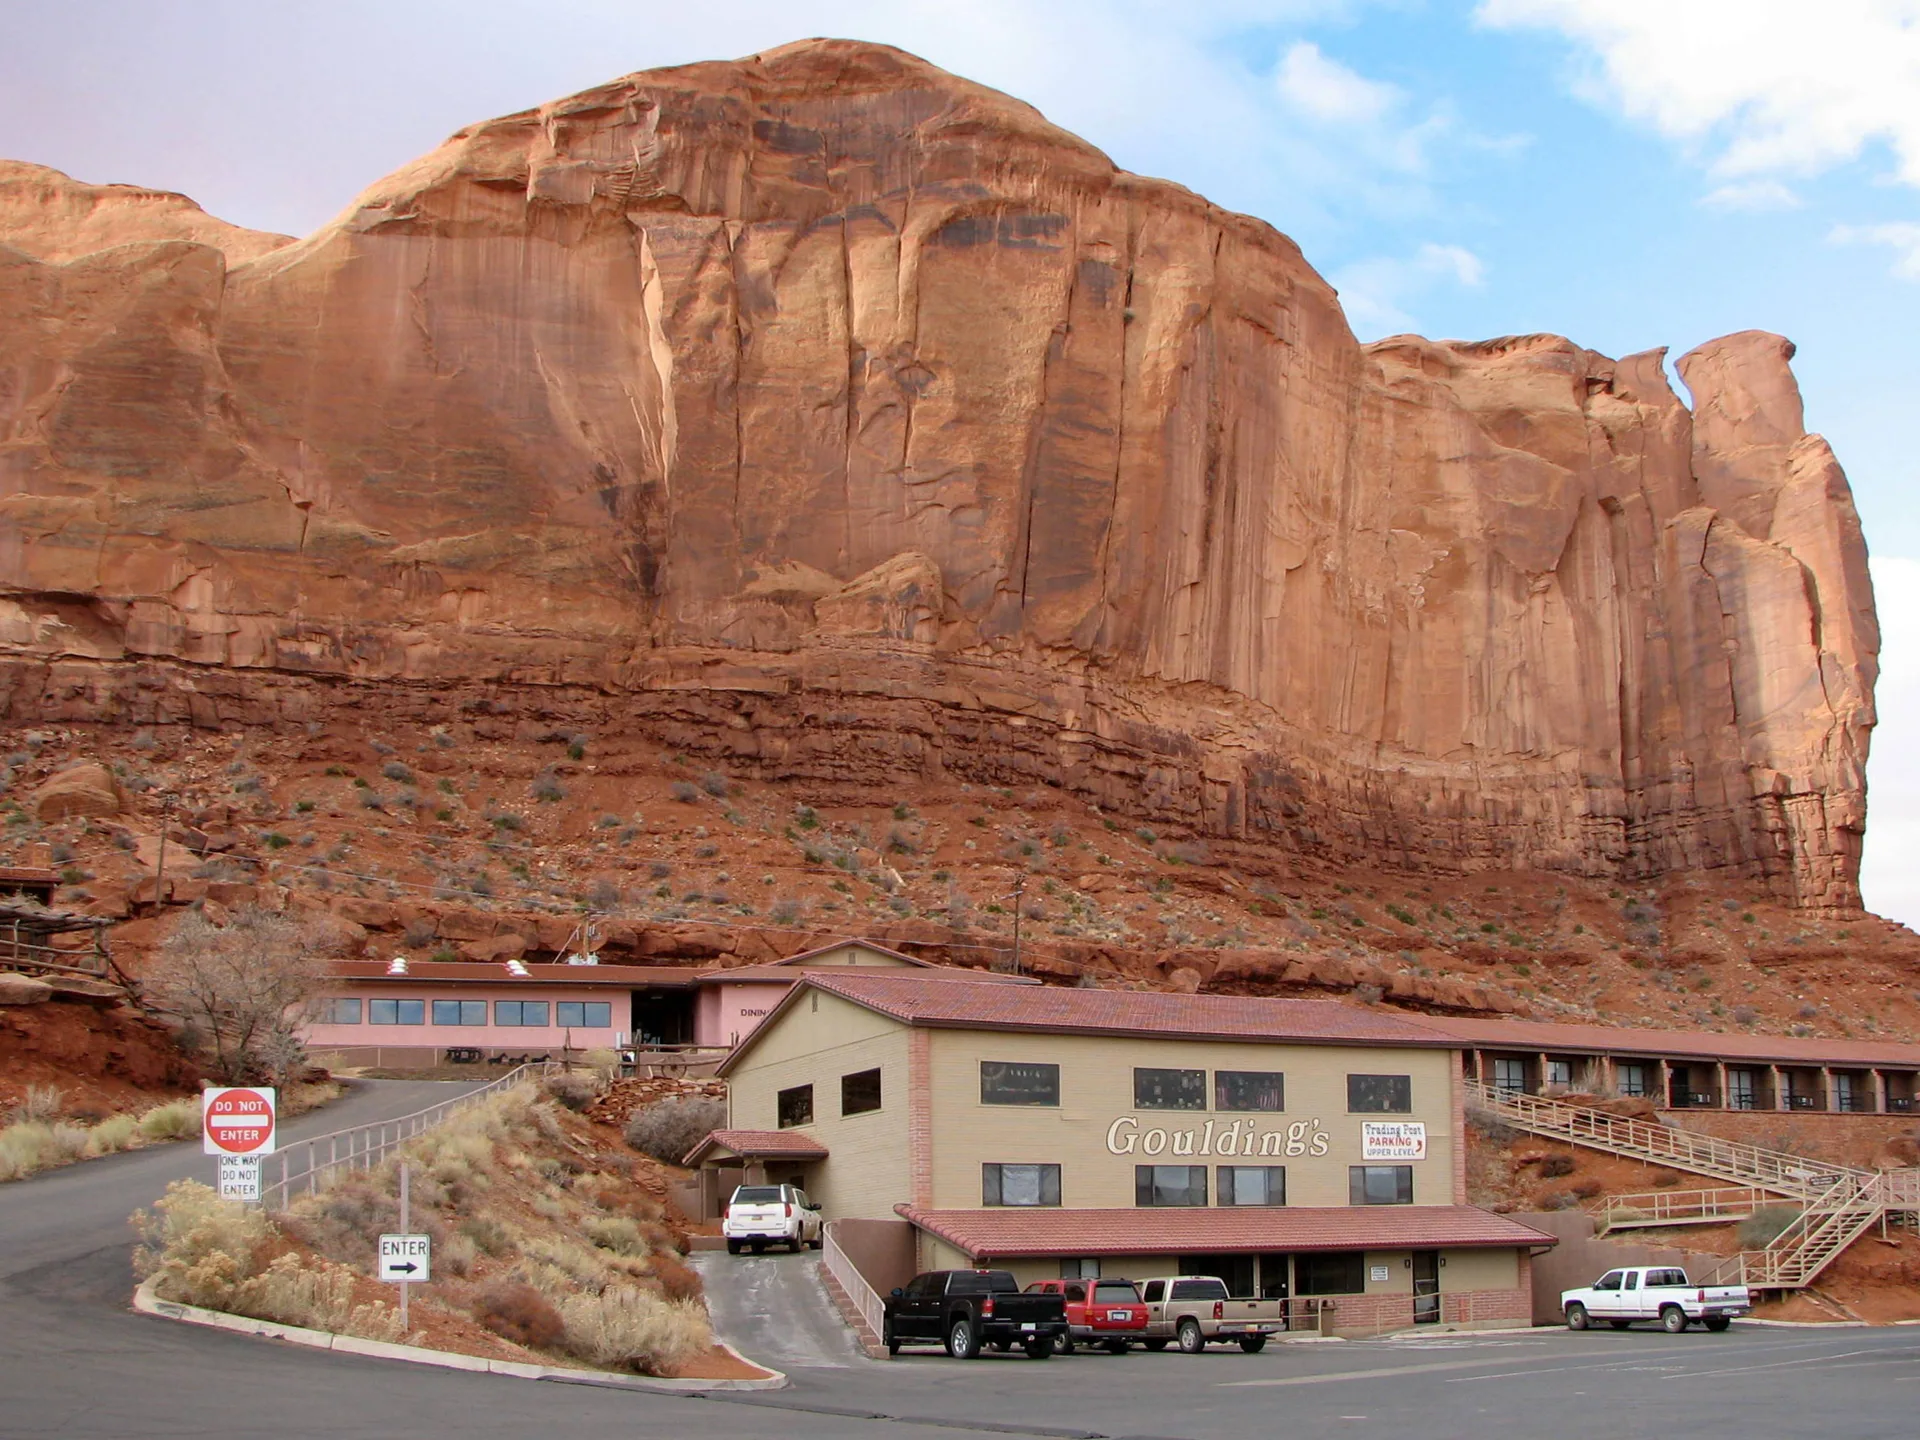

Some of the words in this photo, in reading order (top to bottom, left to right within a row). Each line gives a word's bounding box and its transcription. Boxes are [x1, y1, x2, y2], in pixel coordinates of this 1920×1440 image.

[215, 1101, 233, 1112] DO
[239, 1101, 264, 1112] NOT
[220, 1129, 260, 1141] ENTER
[1105, 1115, 1331, 1157] Goulding's
[1364, 1123, 1400, 1138] Trading
[1403, 1124, 1422, 1135] Post
[1369, 1136, 1412, 1147] PARKING
[1366, 1148, 1392, 1156] UPPER
[1393, 1148, 1416, 1156] LEVEL
[221, 1156, 239, 1166] ONE
[241, 1156, 258, 1166] WAY
[222, 1170, 236, 1180] DO
[238, 1170, 257, 1180] NOT
[223, 1184, 256, 1195] ENTER
[382, 1241, 427, 1255] ENTER
